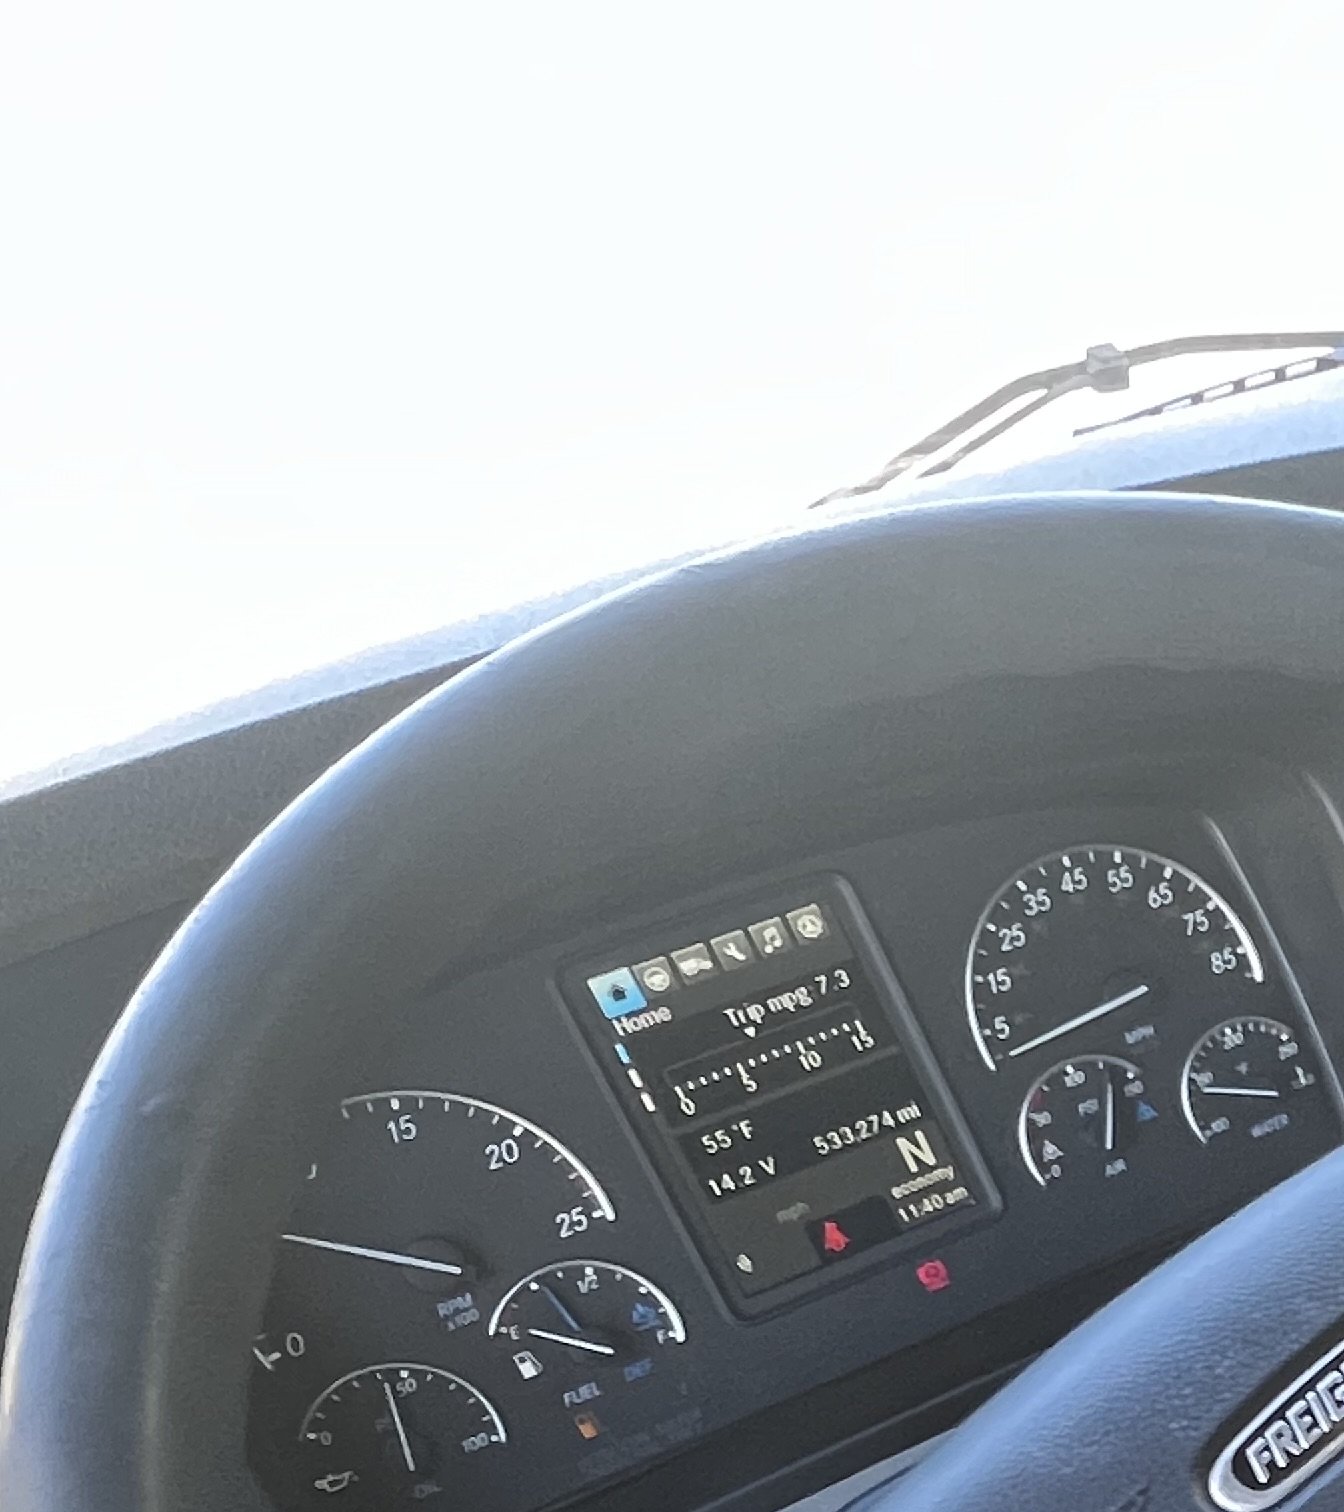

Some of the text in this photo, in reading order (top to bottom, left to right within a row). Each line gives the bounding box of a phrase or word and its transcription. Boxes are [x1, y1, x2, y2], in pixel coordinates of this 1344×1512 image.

[1060, 866, 1088, 893] 45
[1106, 864, 1135, 893] 55
[1022, 888, 1052, 917] 35
[1147, 882, 1174, 909] 65
[1181, 908, 1210, 936] 75
[998, 923, 1026, 951] 25
[1209, 945, 1238, 975] 85
[986, 967, 1013, 994] 15
[722, 968, 851, 1028] Trip mpg 7.3
[611, 1006, 672, 1036] Home
[993, 1016, 1011, 1040] 5
[680, 1031, 876, 1116] 0 5 10 15
[895, 1099, 922, 1125] mi
[386, 1113, 418, 1144] 15
[484, 1138, 521, 1171] 20
[894, 1129, 938, 1174] N
[707, 1156, 777, 1197] 14.2 V
[890, 1164, 955, 1200] economy
[554, 1206, 589, 1239] 25
[435, 1292, 475, 1319] RPM
[286, 1331, 306, 1358] 0
[562, 1381, 602, 1408] FUEL
[460, 1432, 490, 1453] 100
